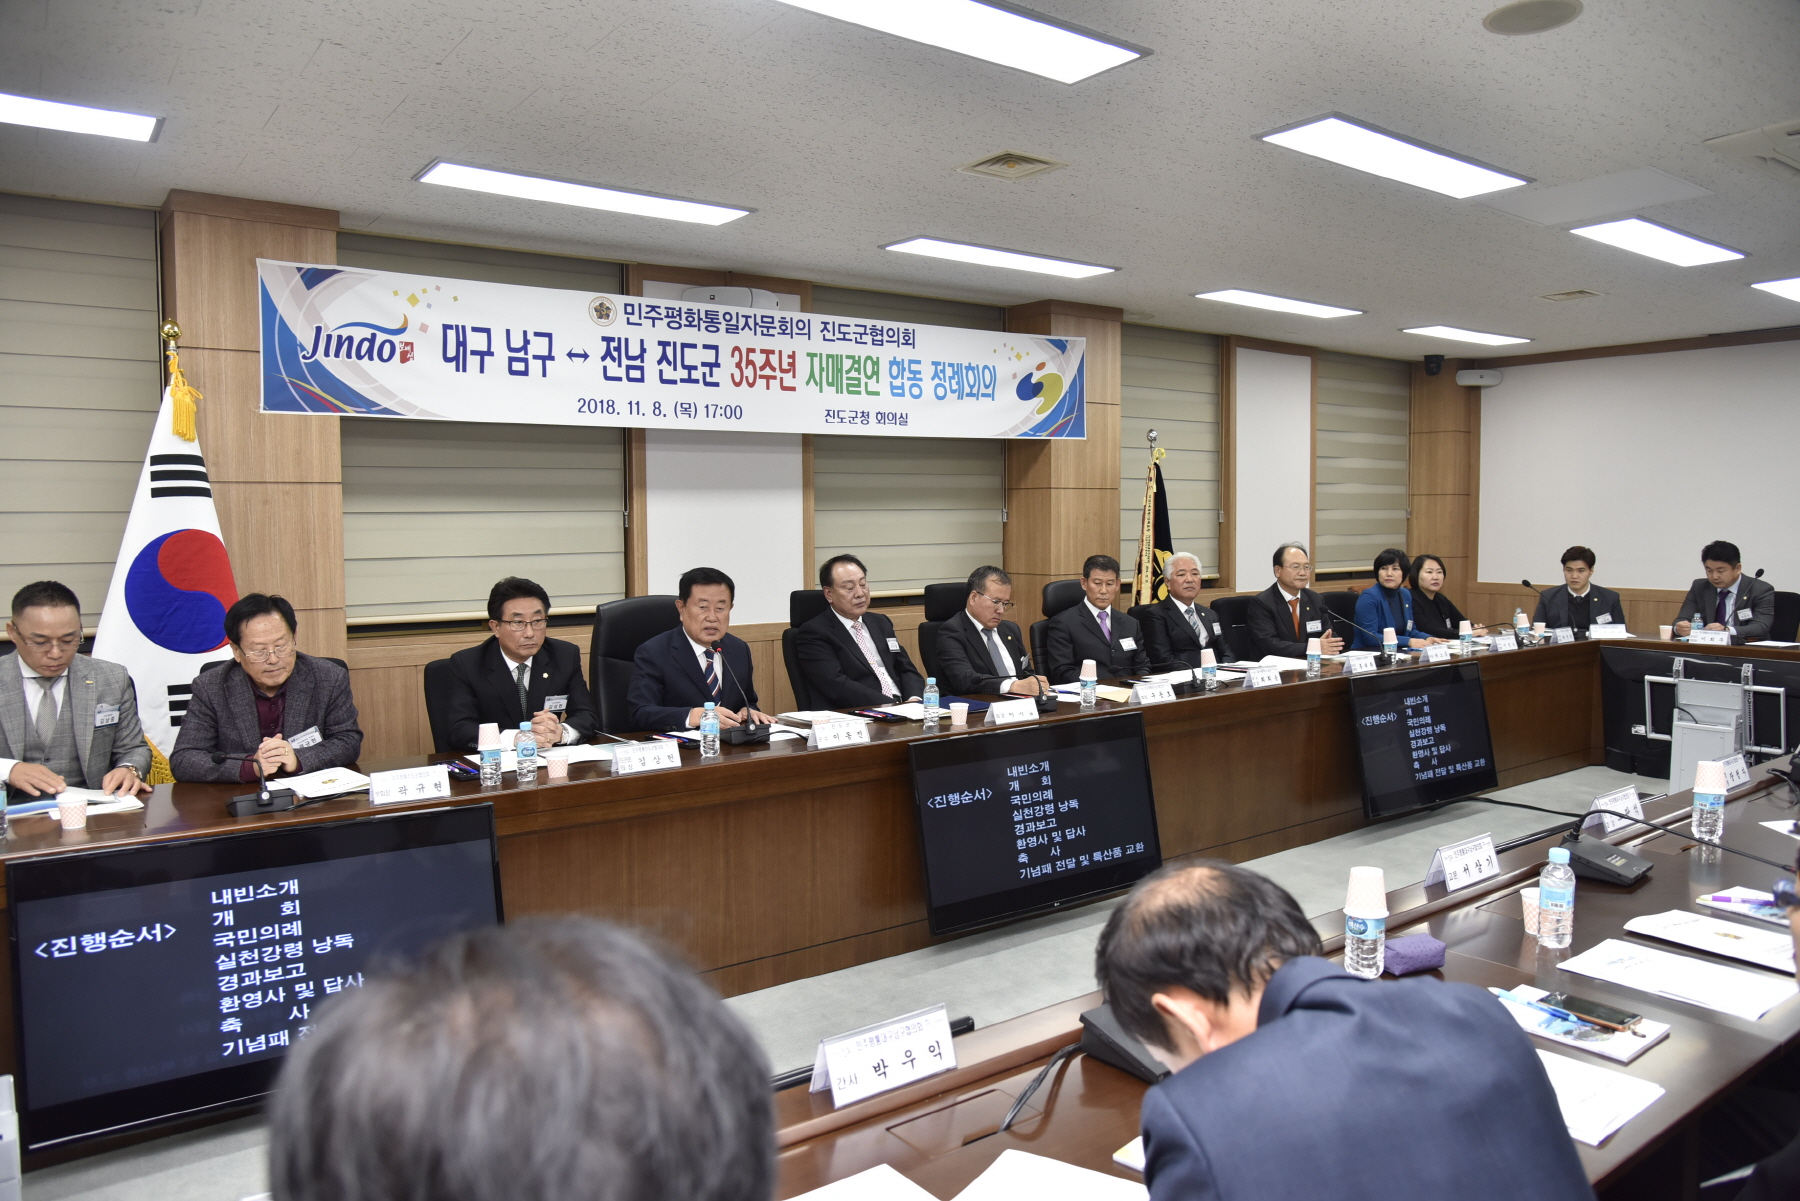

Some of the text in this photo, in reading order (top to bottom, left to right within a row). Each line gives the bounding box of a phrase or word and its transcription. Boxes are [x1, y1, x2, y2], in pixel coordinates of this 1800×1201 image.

[624, 303, 916, 349] 민주평화통일자문회의 진도군협의회
[301, 325, 397, 363] Jindo
[442, 323, 997, 401] 대구 남구 전남 진도군 35주년 자매결연 합동 정례회의
[577, 398, 743, 420] 2018. 11. 8. (목) 17:00
[824, 409, 909, 427] 진도군청 회의실
[1007, 760, 1050, 778] 내빈소개
[1009, 775, 1052, 792] 개 회
[1010, 788, 1054, 806] 국민의례
[927, 788, 993, 809] <진행순서>
[1012, 799, 1079, 822] 실천강령 낭독
[1014, 818, 1057, 836] 경과보고
[1016, 826, 1086, 850] 환영사 및 답사
[1018, 846, 1061, 864] 축 사
[1019, 842, 1144, 879] 기념패 전달 및 특산품 교환
[211, 879, 300, 905] 내빈소개
[213, 899, 301, 927] 개 회
[34, 923, 177, 958] <진행순서>
[213, 920, 303, 948] 국민의례
[215, 933, 355, 971] 실천강령 낭독
[218, 962, 307, 992] 경과보고
[219, 972, 365, 1014] 환영사 및 답사
[220, 1003, 310, 1033] 축 사
[222, 1029, 290, 1057] 기념패
